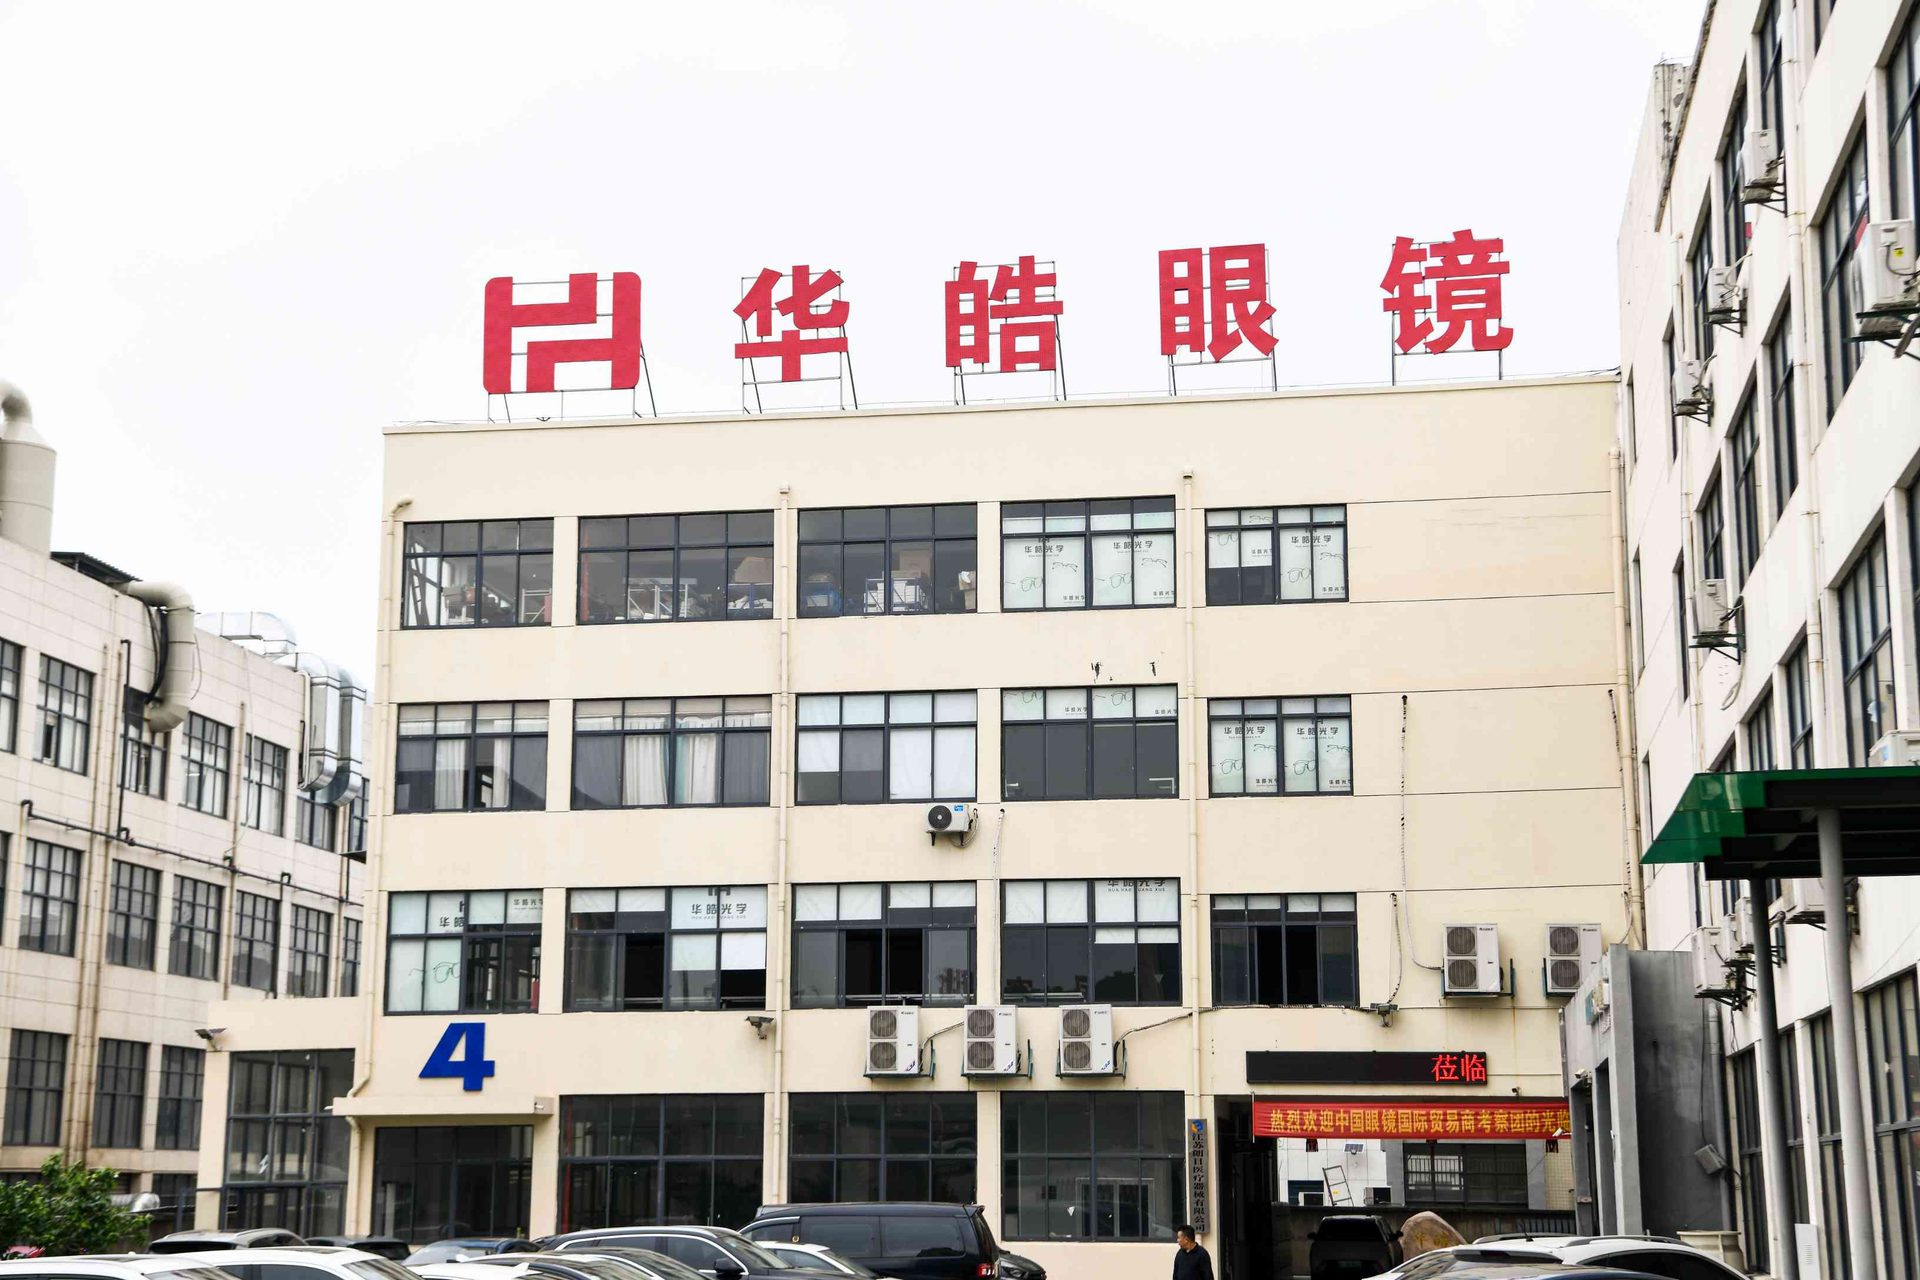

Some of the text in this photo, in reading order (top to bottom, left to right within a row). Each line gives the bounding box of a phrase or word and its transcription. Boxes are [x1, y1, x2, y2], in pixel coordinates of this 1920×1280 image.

[733, 229, 1514, 382] 华皓眼镜
[691, 903, 747, 915] 华皓光学
[418, 1022, 496, 1092] 4
[1431, 1054, 1487, 1082] 莅临
